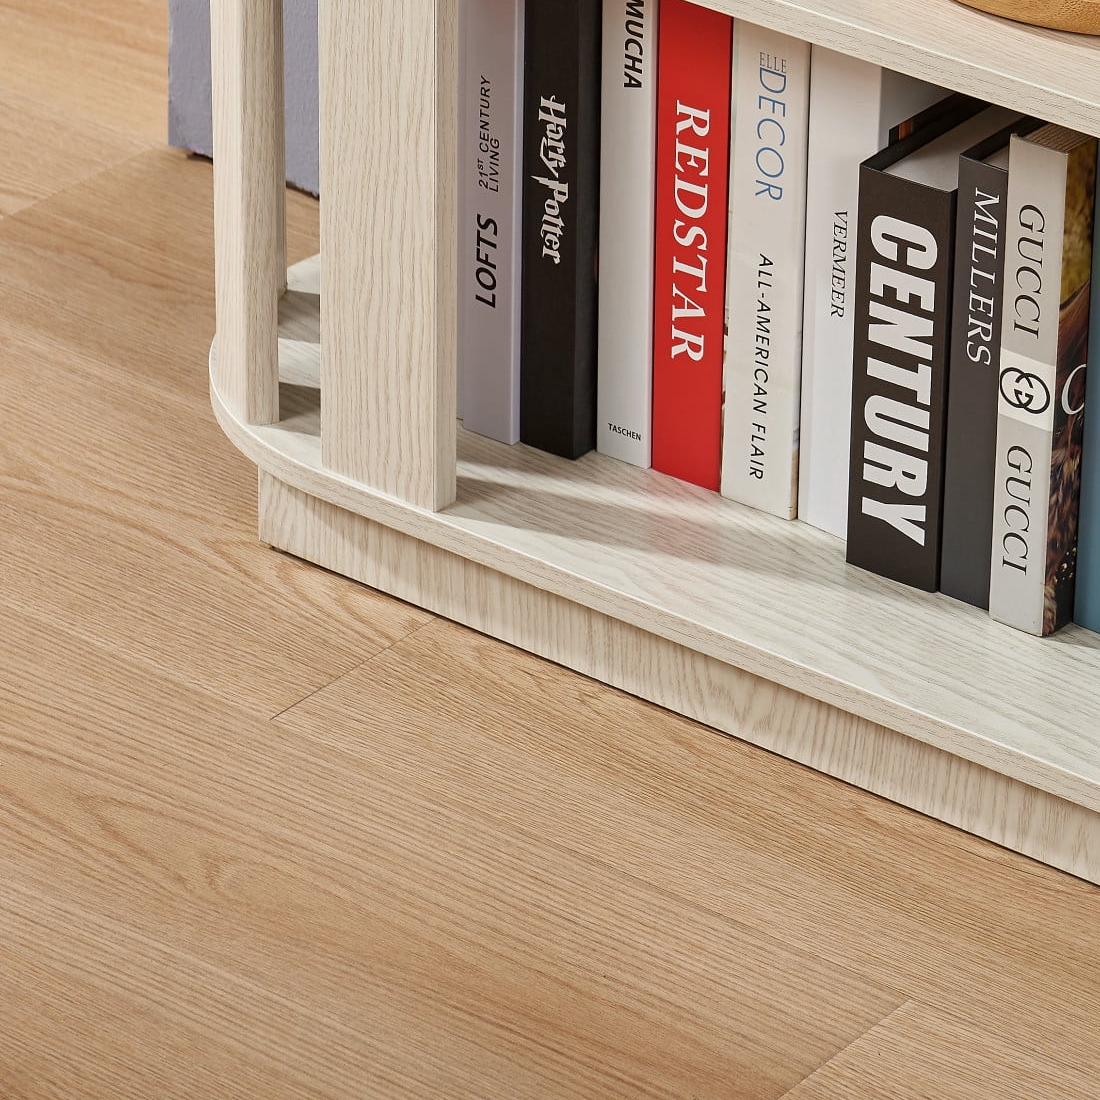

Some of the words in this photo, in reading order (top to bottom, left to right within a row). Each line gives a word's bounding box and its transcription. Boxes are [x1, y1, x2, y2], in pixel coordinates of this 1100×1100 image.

[479, 74, 492, 153] CENTURY
[759, 51, 788, 74] ELLE
[488, 136, 501, 193] LIVING
[537, 93, 568, 179] Harry
[754, 66, 788, 201] DECOR
[475, 212, 499, 309] LOFTS
[530, 175, 570, 266] Potter
[670, 99, 711, 362] REDSTAR
[830, 210, 849, 318] VERMEER
[966, 186, 1001, 366] MILLERS
[1012, 204, 1046, 340] GUCCI
[752, 252, 774, 414] ALL-AMERICAN
[861, 214, 938, 547] CENTURY
[607, 422, 642, 442] TASCHEN
[749, 421, 767, 481] FLAIR
[1001, 445, 1033, 577] GUCCI
